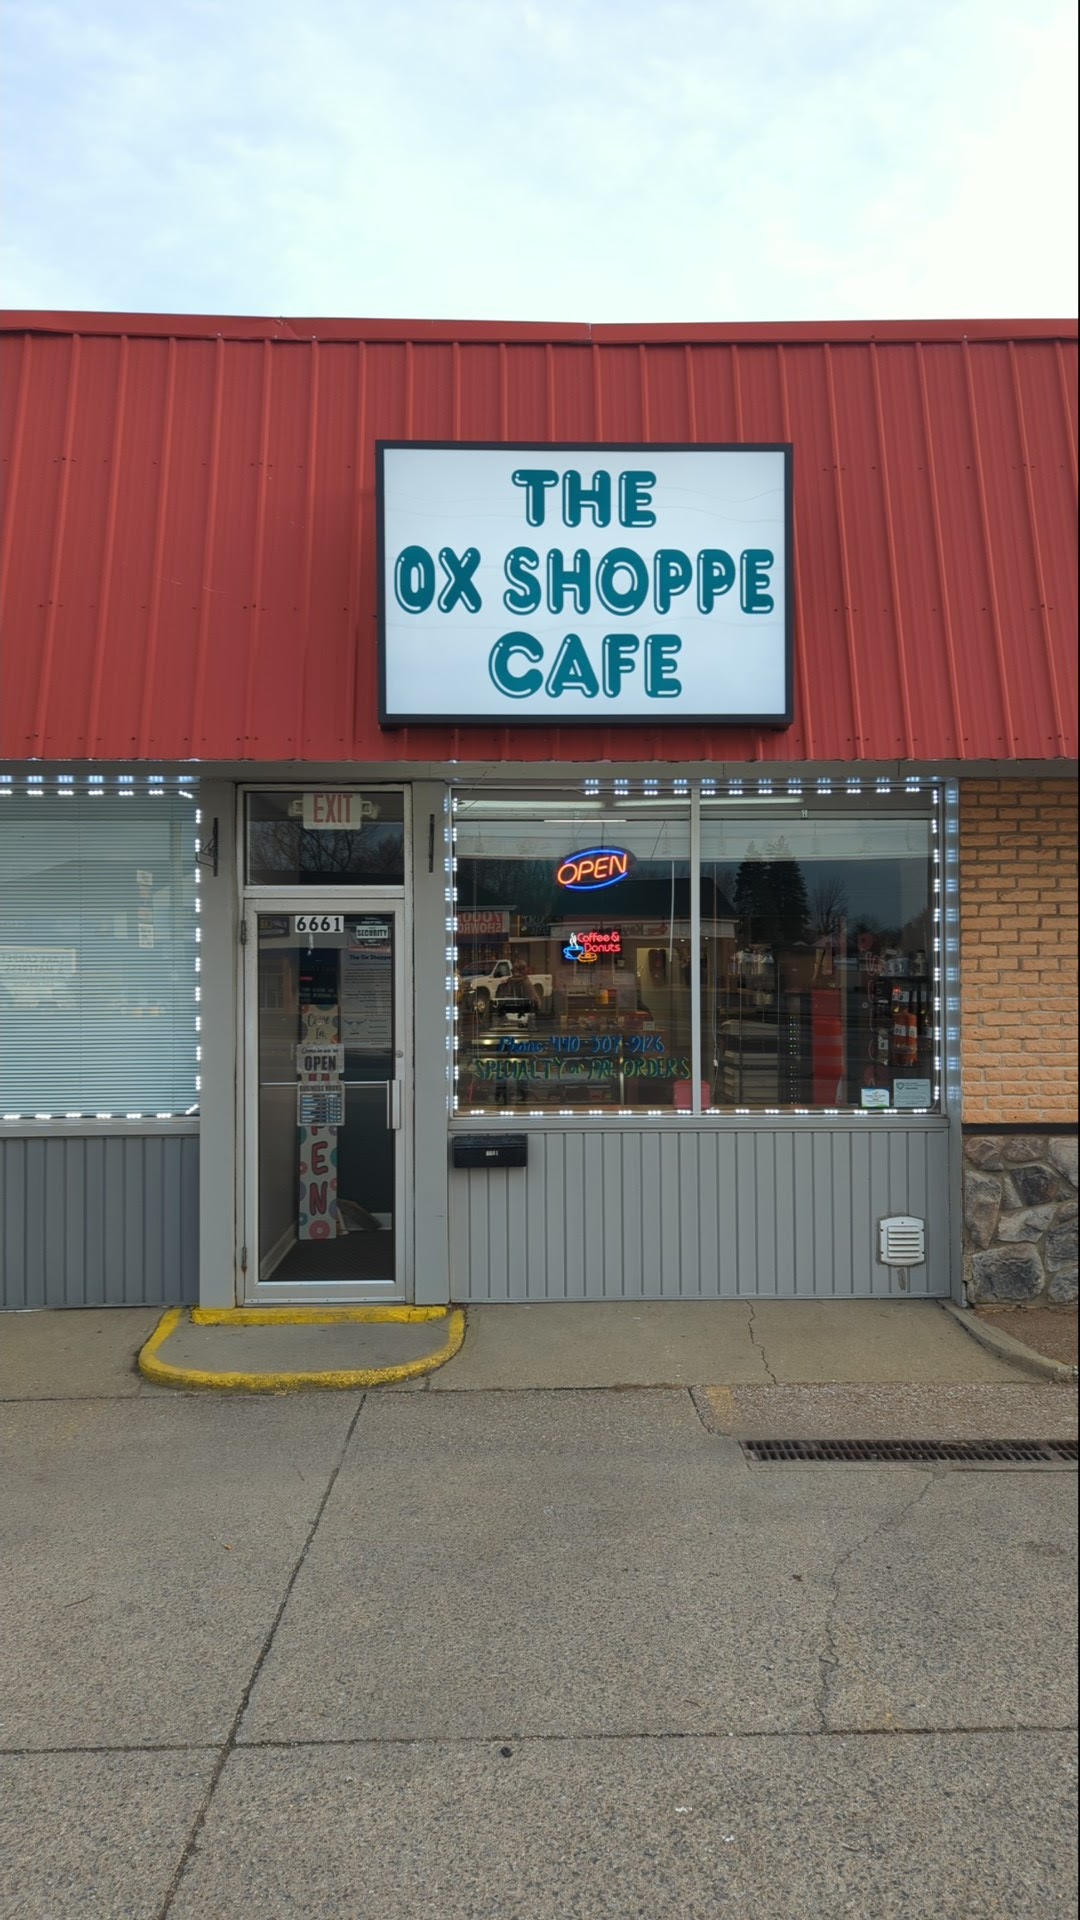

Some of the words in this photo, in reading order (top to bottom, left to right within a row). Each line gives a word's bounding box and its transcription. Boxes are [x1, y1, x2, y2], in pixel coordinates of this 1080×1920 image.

[511, 469, 657, 528] THE
[394, 545, 482, 615] OX
[503, 546, 775, 616] SHOPPE
[488, 631, 682, 699] CAFE
[313, 793, 353, 823] EXIT
[557, 853, 627, 885] OPEN
[297, 916, 341, 932] 6661
[357, 929, 387, 937] SECURITY
[577, 932, 610, 943] Coffee
[610, 931, 620, 943] &
[584, 943, 621, 953] Donuts
[304, 1055, 337, 1071] OPEN
[474, 1057, 568, 1080] SPECIALTY
[623, 1056, 691, 1080] ORDERS
